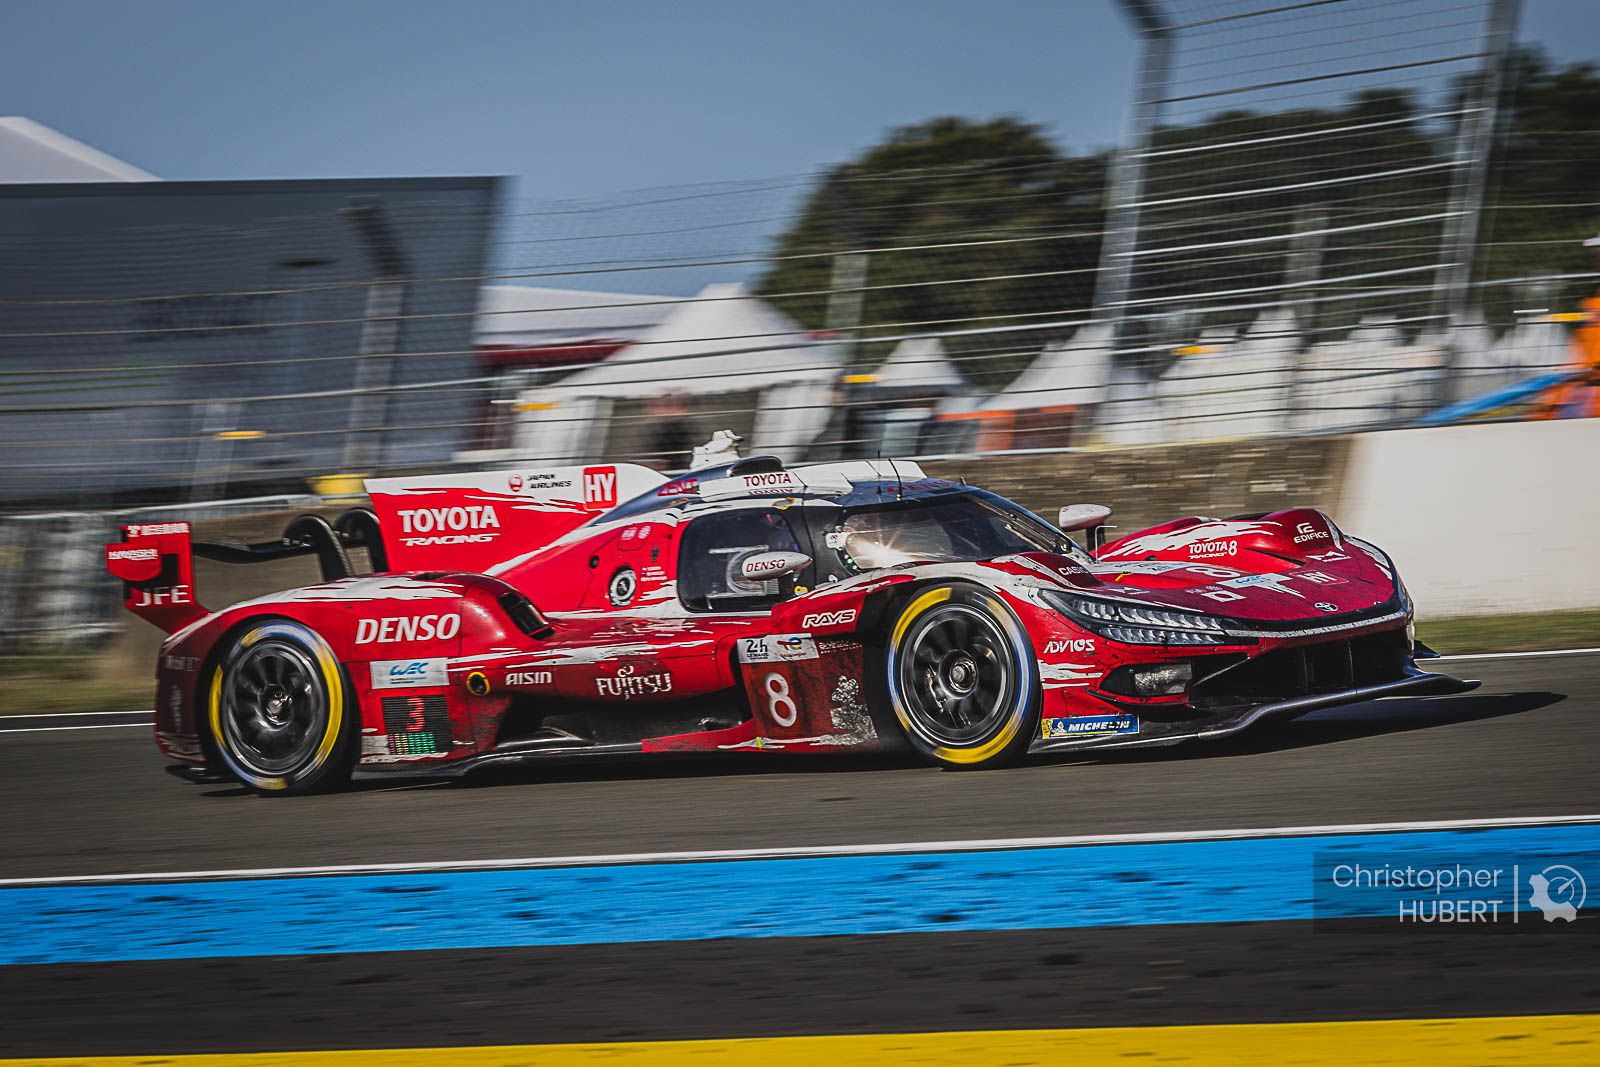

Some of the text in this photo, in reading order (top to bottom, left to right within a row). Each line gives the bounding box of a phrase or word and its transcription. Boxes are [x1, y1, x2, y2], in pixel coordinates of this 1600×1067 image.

[529, 480, 573, 489] AIRLINES
[585, 474, 614, 502] HY
[744, 473, 792, 487] TOYOTA
[397, 505, 501, 533] TOYOTA
[399, 533, 501, 546] RACING
[1293, 531, 1330, 544] EDIFICE
[1188, 540, 1238, 556] TOYOTA 8
[746, 560, 786, 573] DENSO
[136, 585, 191, 606] JFE
[802, 609, 857, 629] RAYS
[355, 613, 461, 644] DENSO
[745, 639, 768, 653] 24h
[389, 662, 430, 676] WEC
[505, 671, 553, 685] AISIN
[596, 666, 673, 700] FUJITSU
[766, 672, 797, 728] 8
[405, 697, 425, 732] 3
